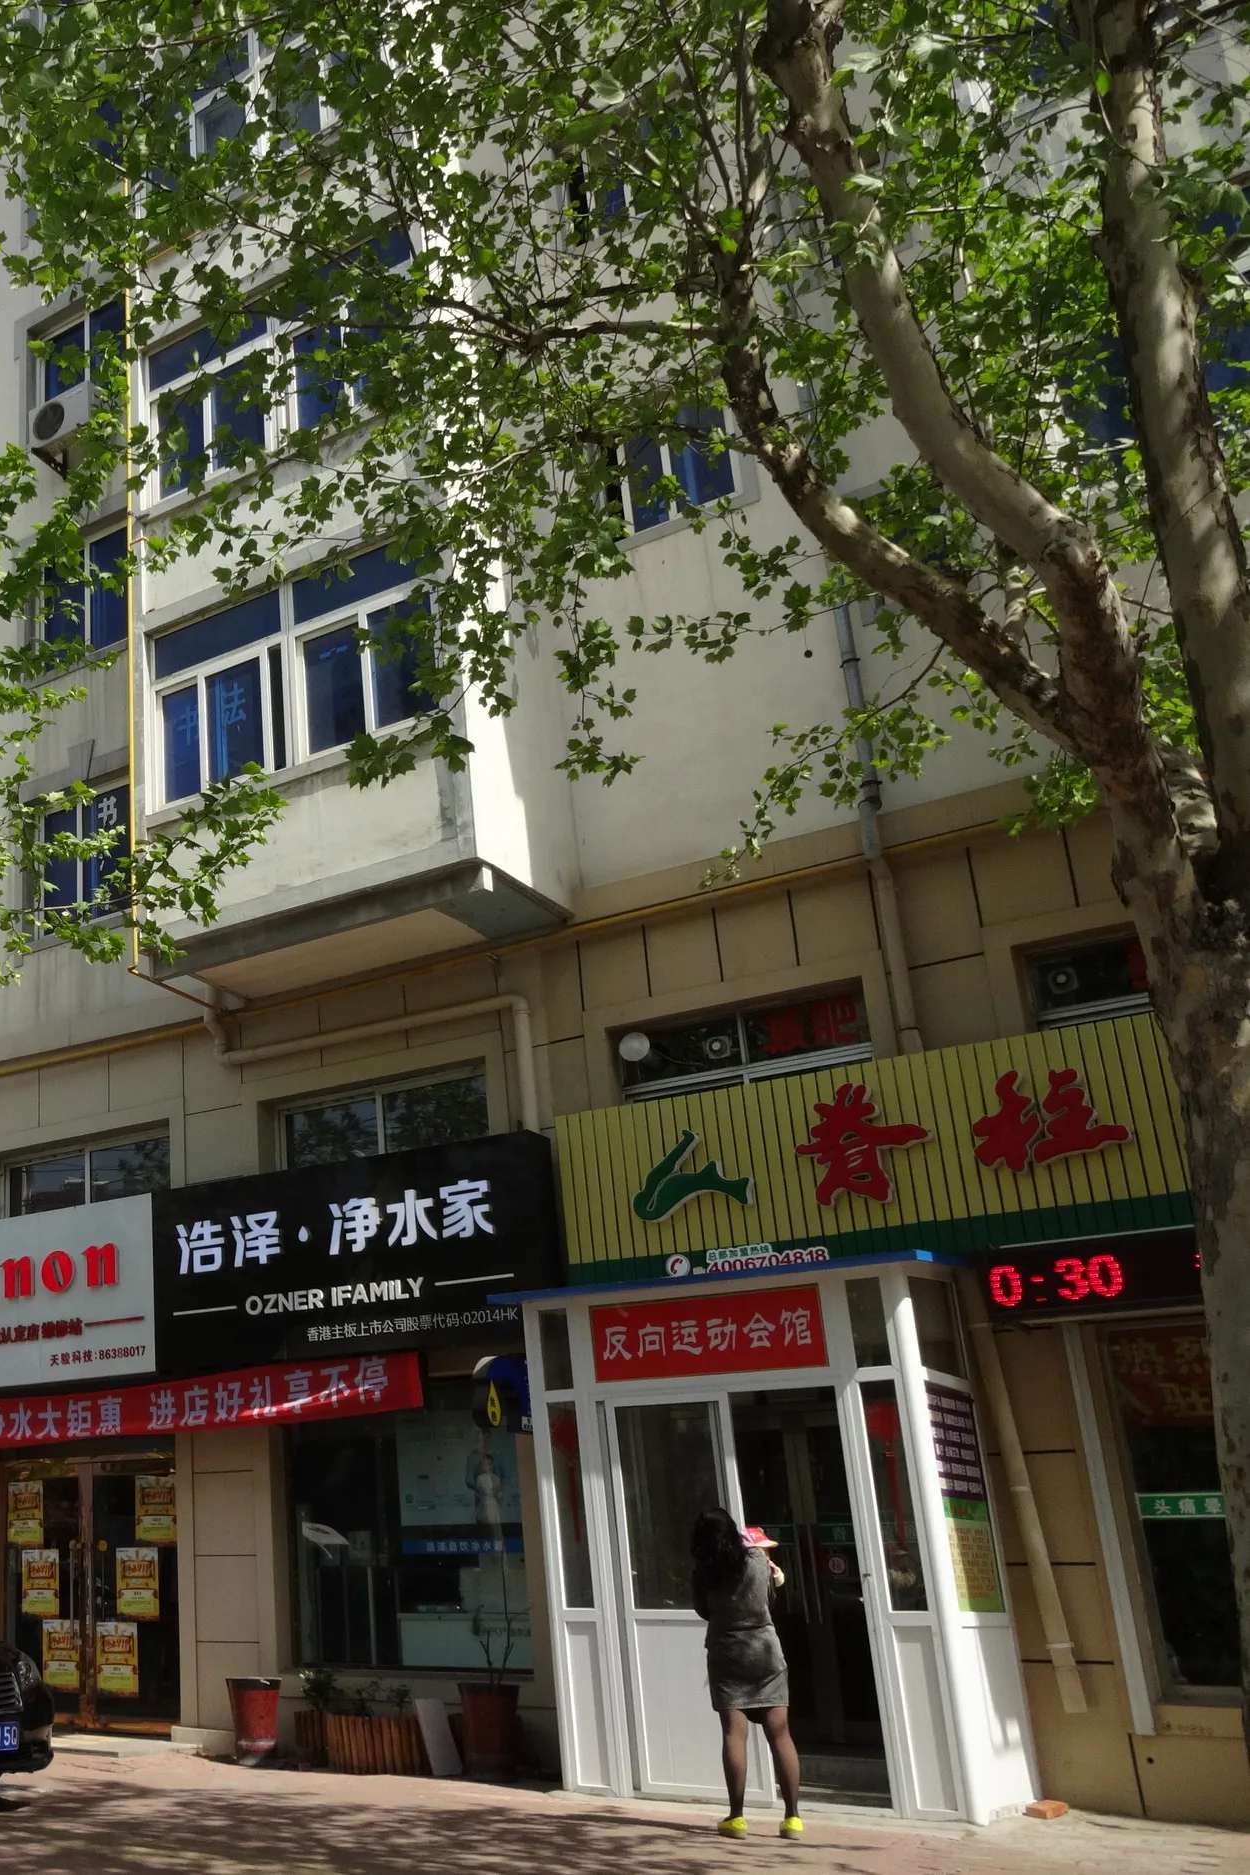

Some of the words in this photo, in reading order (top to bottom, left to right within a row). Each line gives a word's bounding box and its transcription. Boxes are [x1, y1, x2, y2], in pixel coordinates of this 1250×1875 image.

[708, 1248, 829, 1273] 4006704818
[245, 1288, 324, 1316] OZNER
[330, 1276, 425, 1307] IFAMILY
[602, 1307, 812, 1361] 反向运动会馆
[49, 1345, 147, 1367] 天骏科技:86388017
[147, 1356, 390, 1431] 进店好礼享不停
